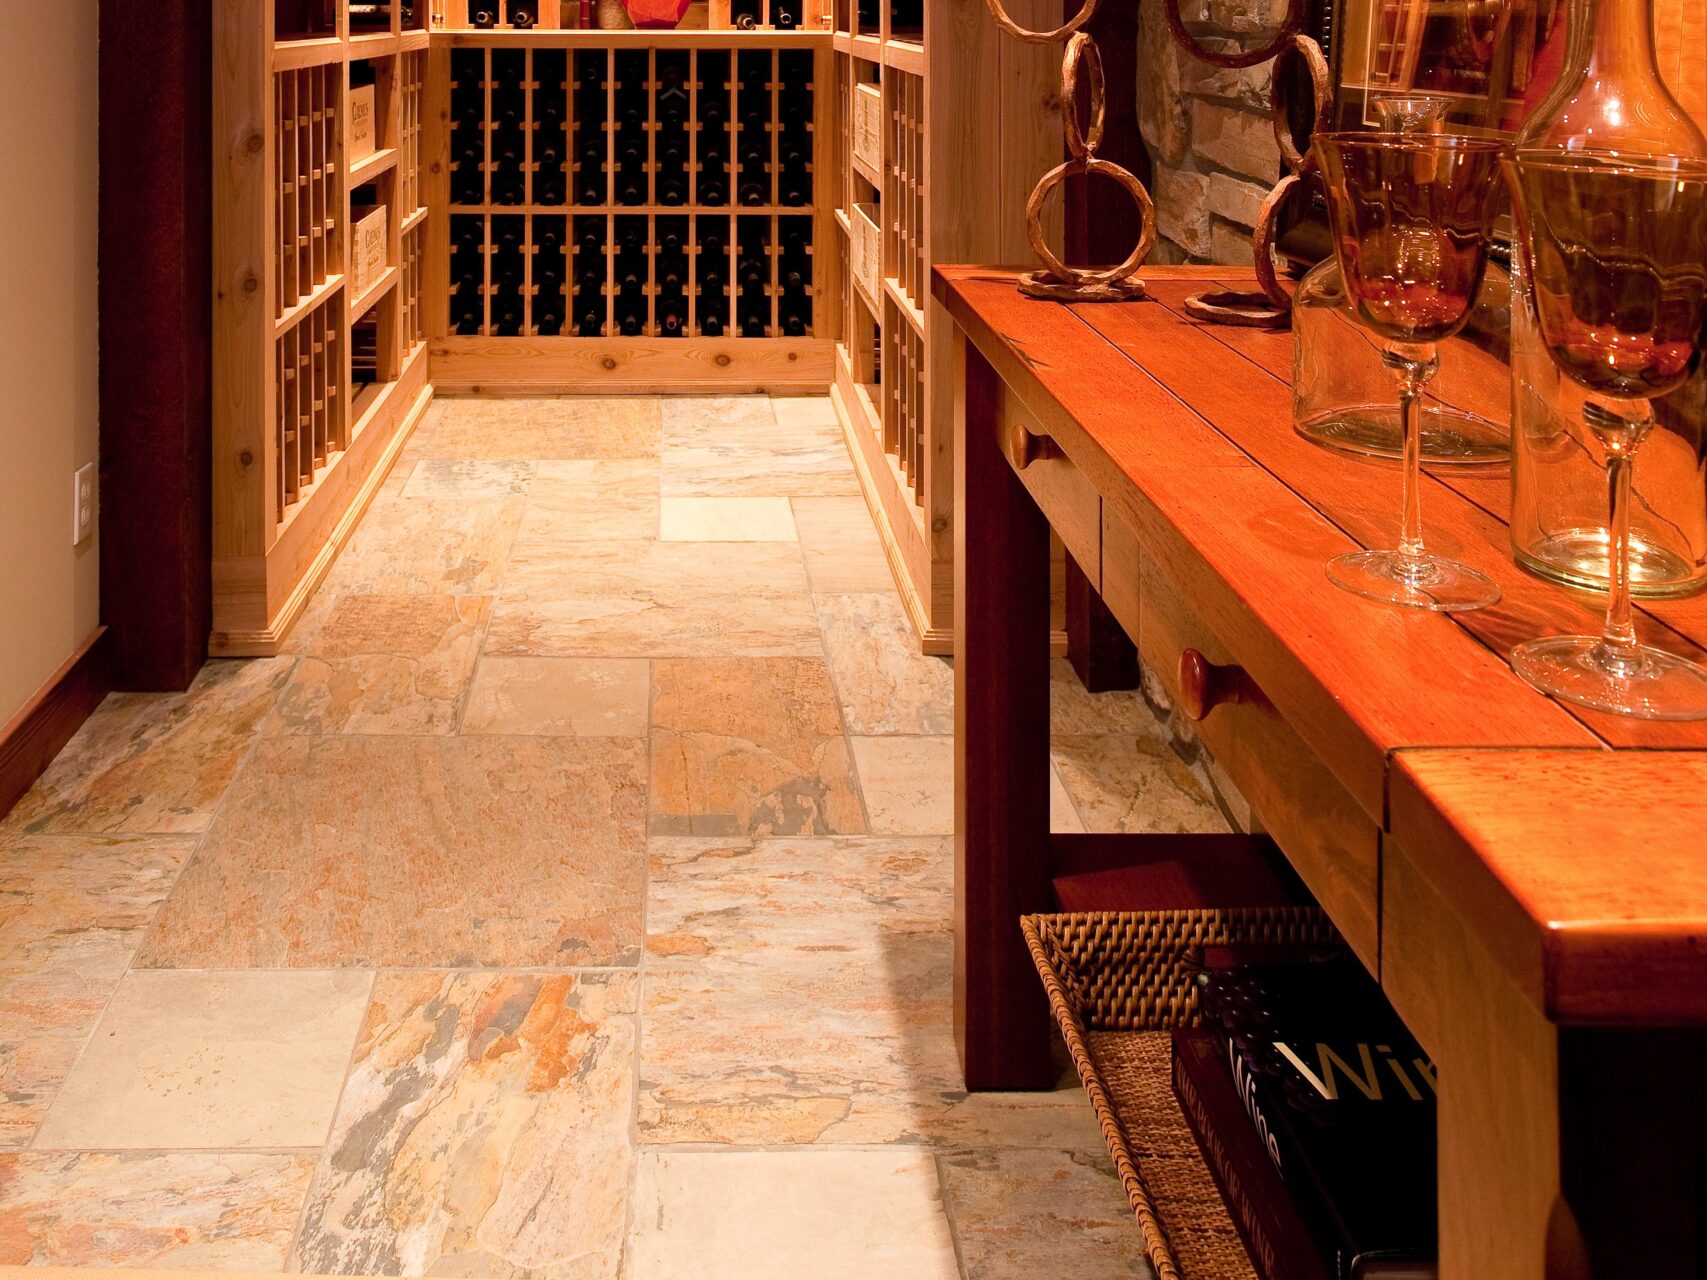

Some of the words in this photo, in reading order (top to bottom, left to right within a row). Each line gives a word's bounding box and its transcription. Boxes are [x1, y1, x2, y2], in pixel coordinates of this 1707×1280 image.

[1177, 1055, 1196, 1118] THE
[1225, 1159, 1241, 1200] OF
[1229, 1037, 1284, 1181] Wine
